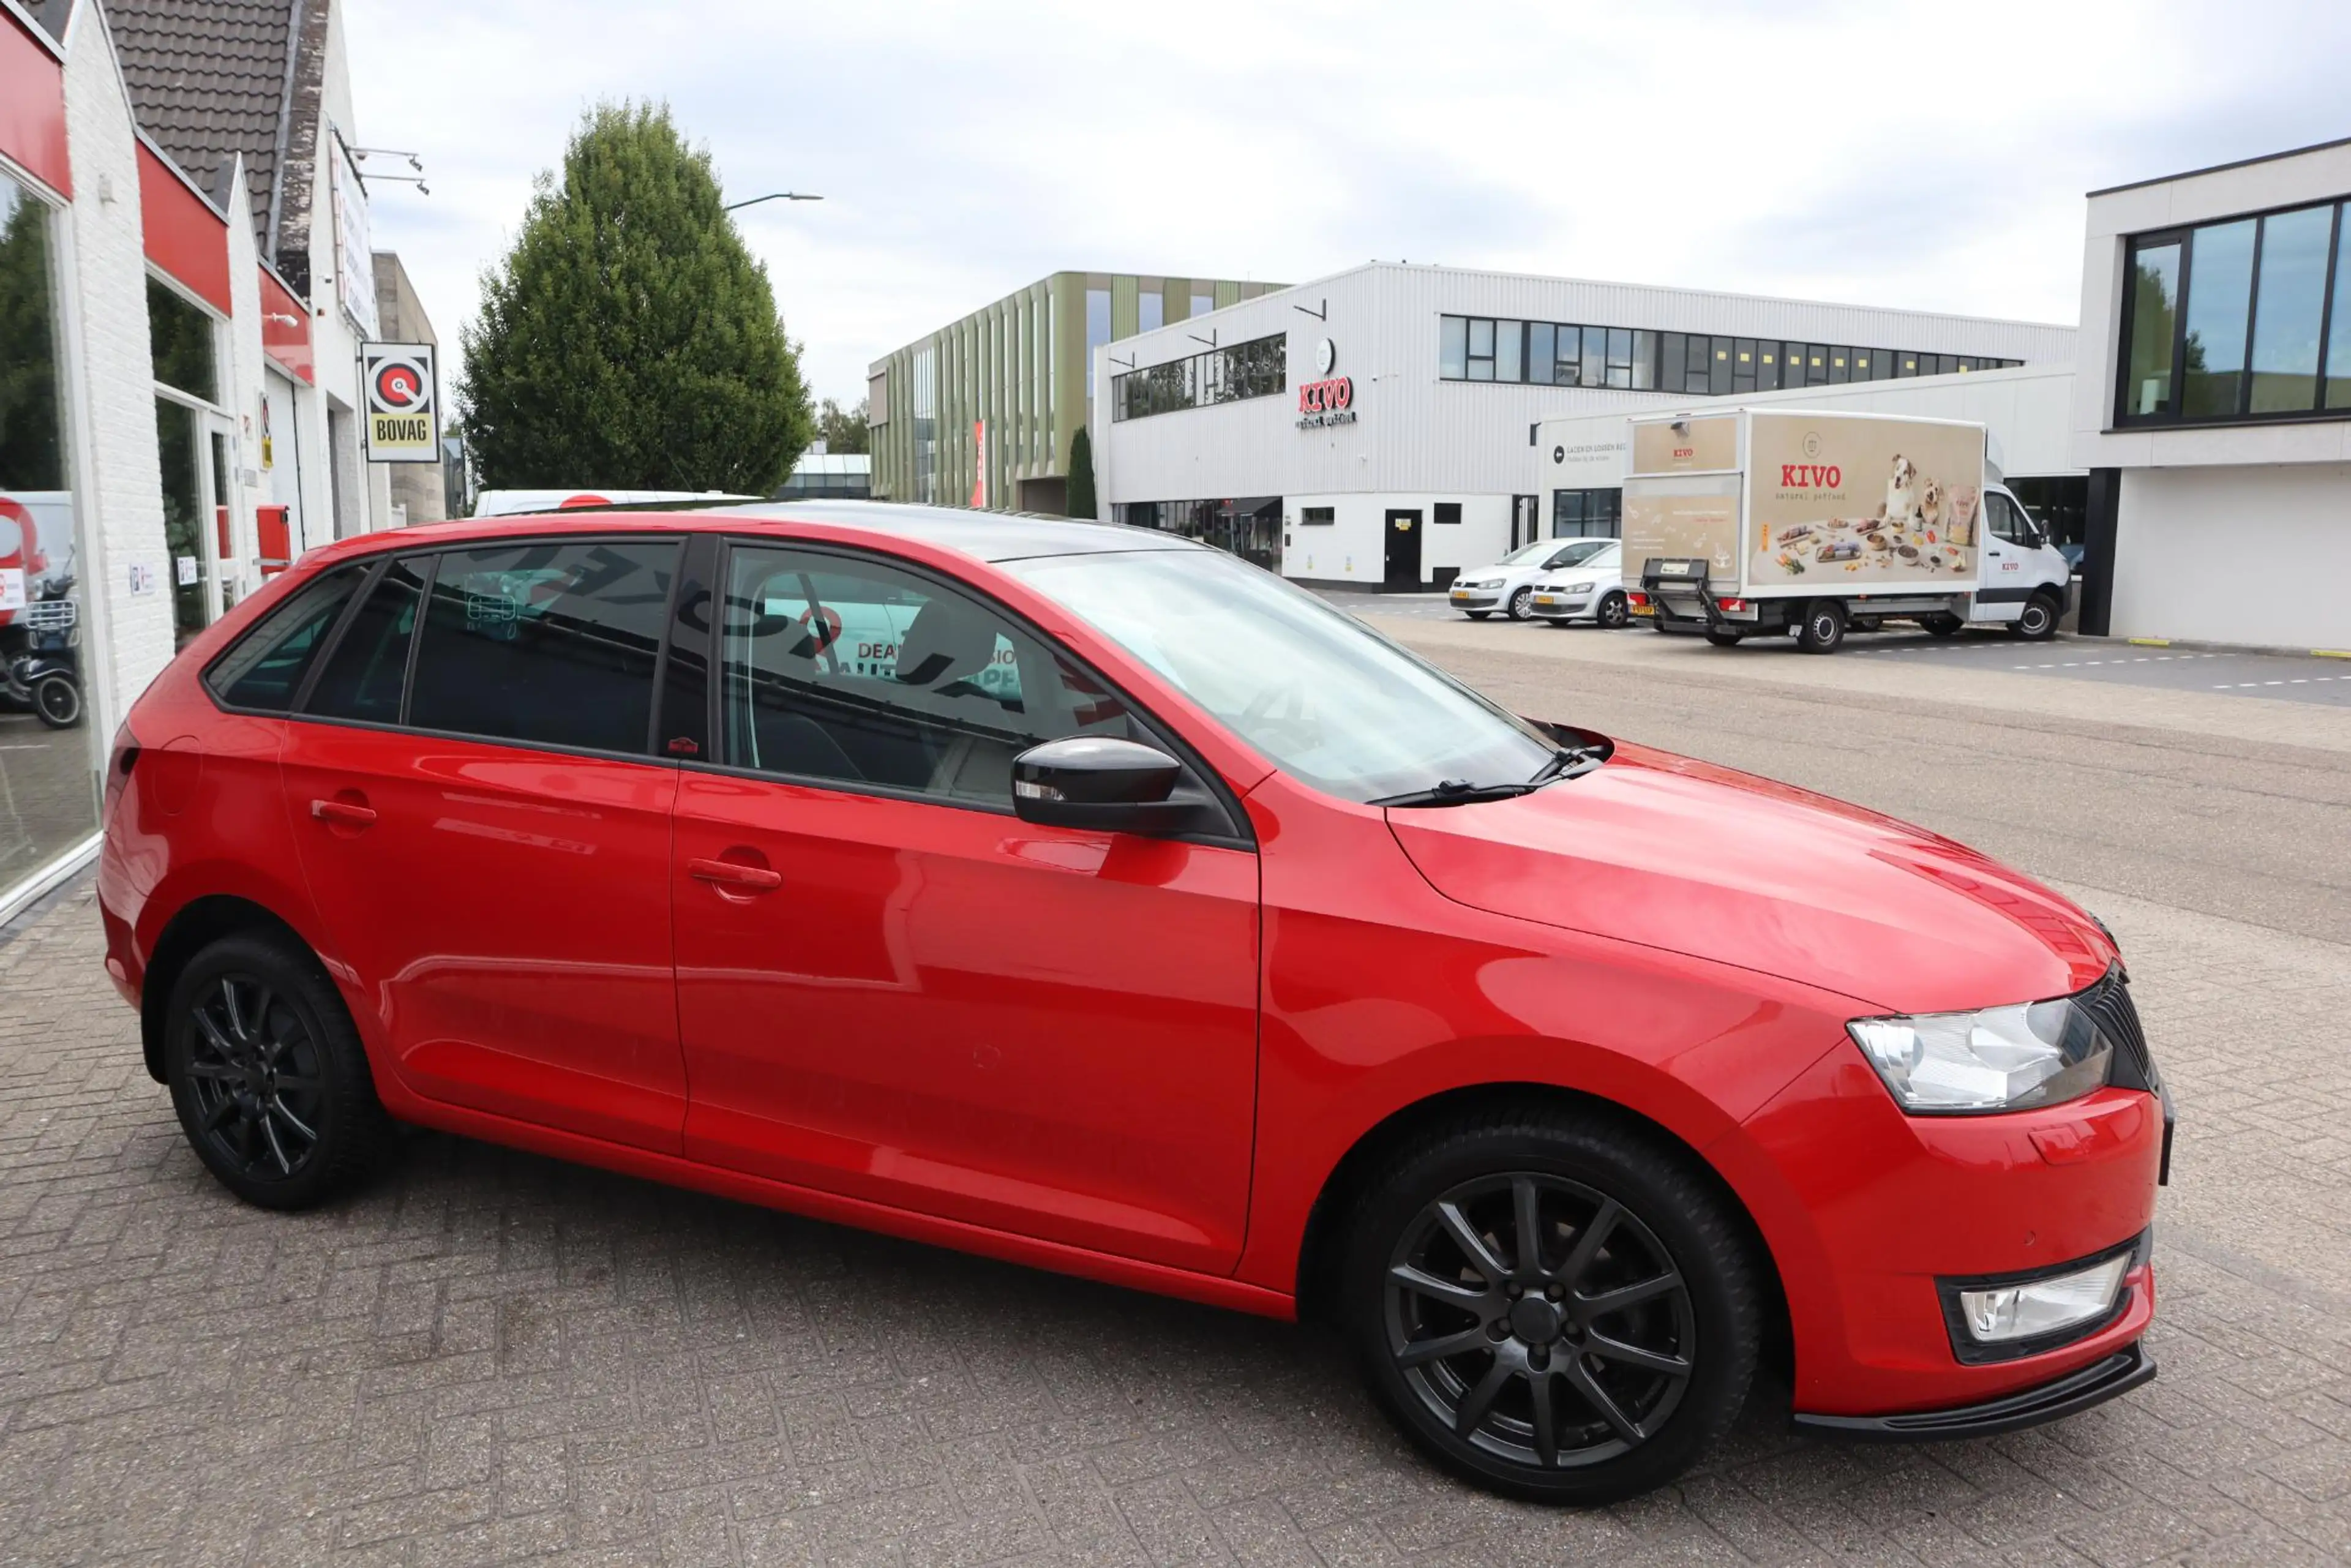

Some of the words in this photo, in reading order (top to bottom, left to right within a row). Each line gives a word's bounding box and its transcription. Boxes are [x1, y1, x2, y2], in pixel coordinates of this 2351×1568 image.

[1299, 376, 1351, 413] KIVO
[376, 419, 427, 441] BOVAG
[1674, 448, 1693, 457] KIVO
[1781, 464, 1841, 489] KIVO
[2001, 561, 2019, 571] KIVO
[858, 642, 902, 659] DEA
